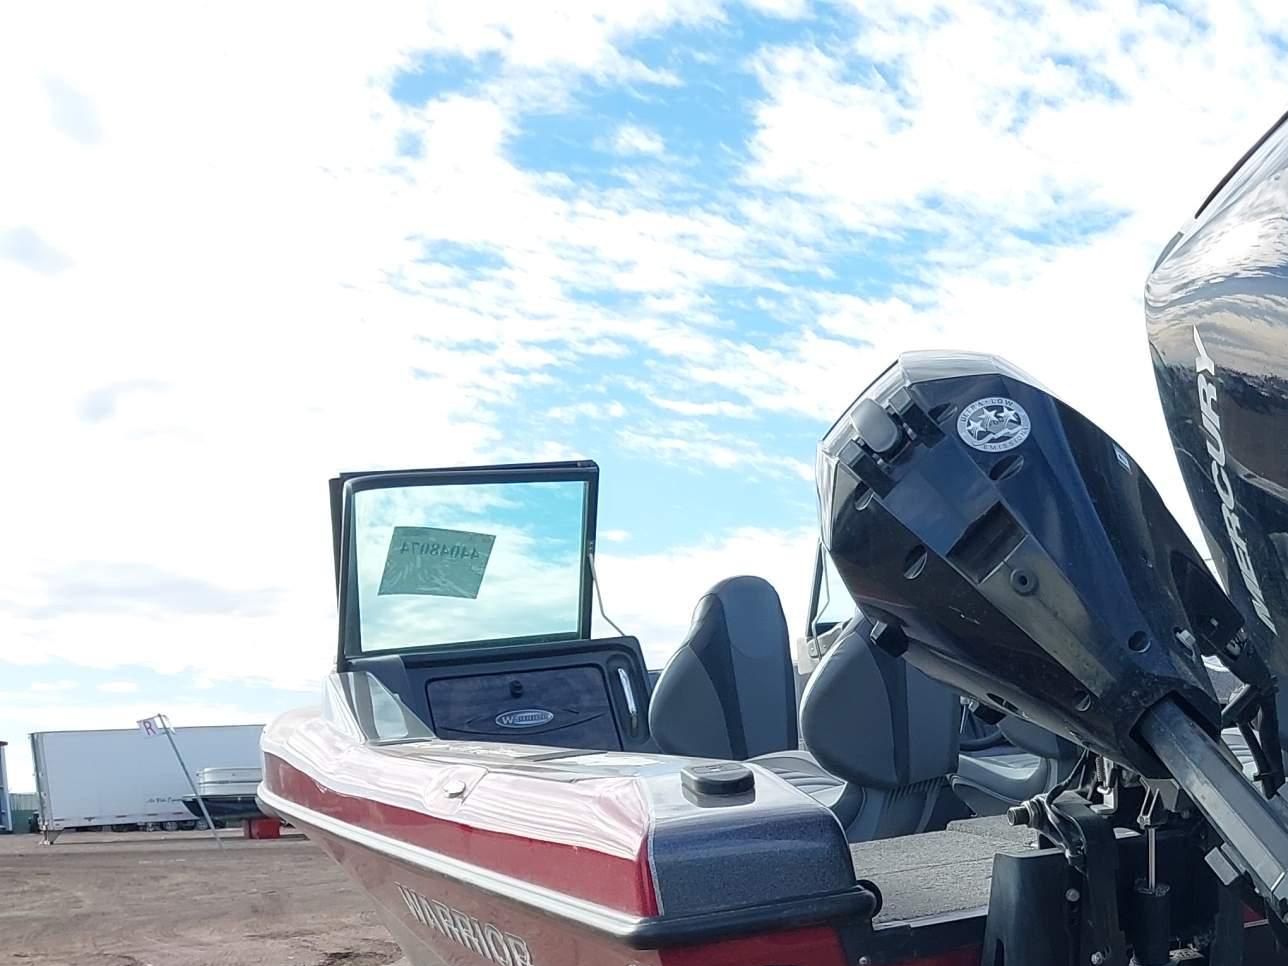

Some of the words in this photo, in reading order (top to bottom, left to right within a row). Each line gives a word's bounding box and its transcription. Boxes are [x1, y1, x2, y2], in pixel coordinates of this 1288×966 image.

[960, 400, 985, 423] ULTRA
[991, 398, 1014, 407] LOW
[1192, 322, 1278, 637] MERCURY
[143, 720, 157, 737] R
